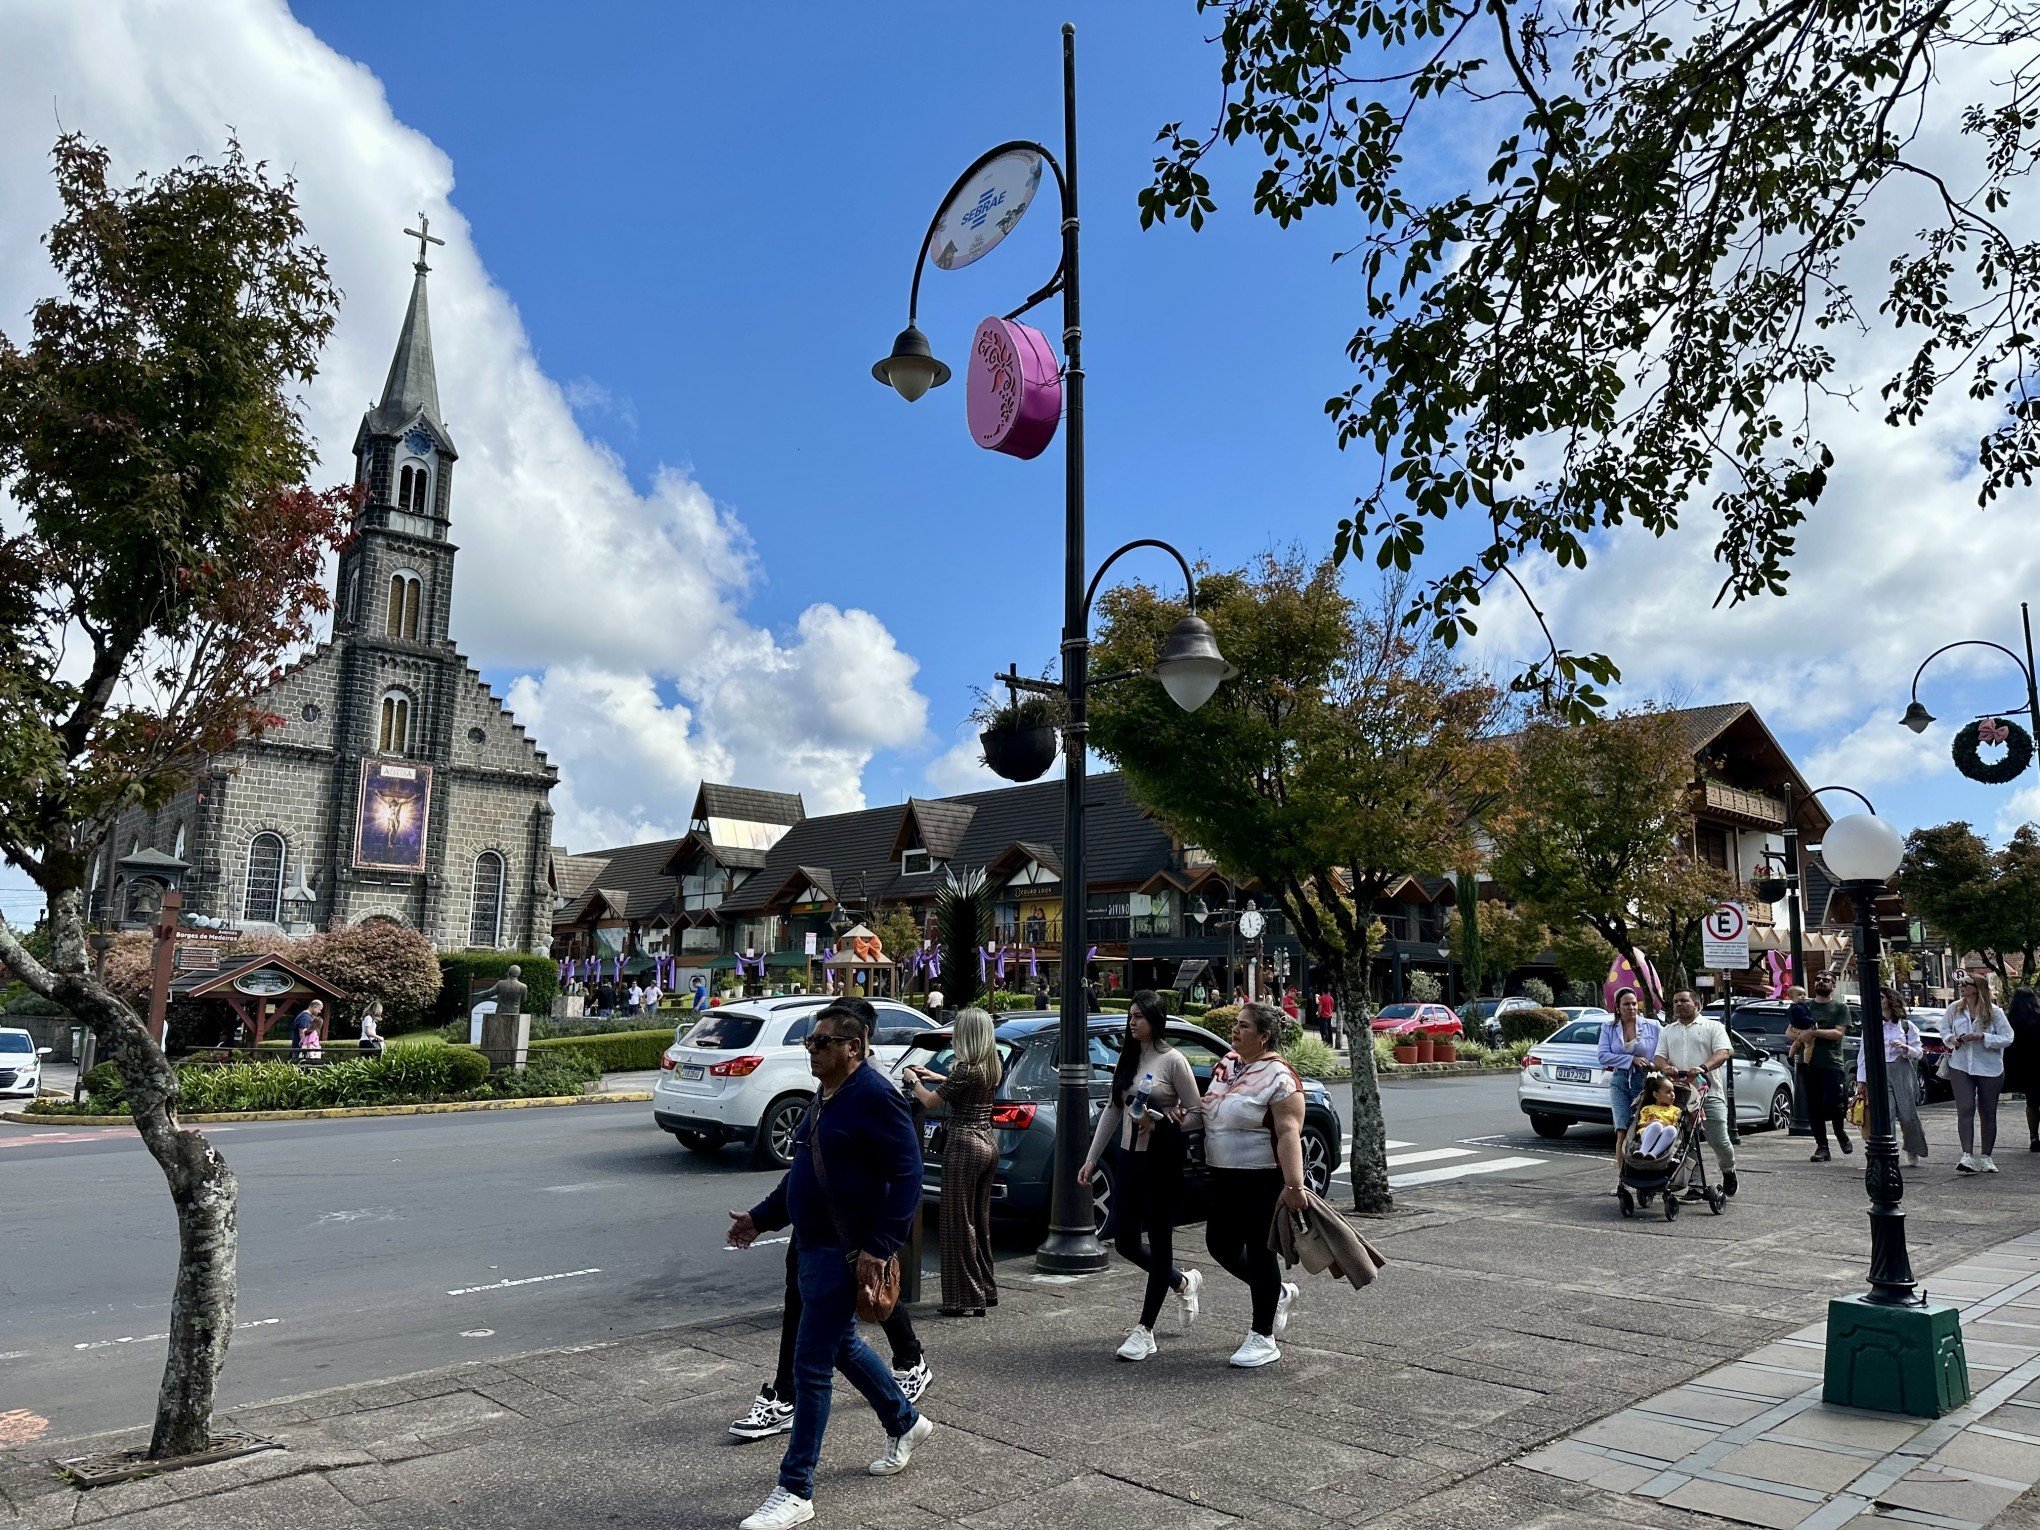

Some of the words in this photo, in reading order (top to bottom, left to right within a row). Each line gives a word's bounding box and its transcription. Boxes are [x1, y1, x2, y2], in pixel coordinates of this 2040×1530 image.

[960, 190, 1007, 226] SEBRAE
[1020, 887, 1037, 895] COURO
[1108, 903, 1130, 915] DIVINO
[1718, 911, 1731, 933] E
